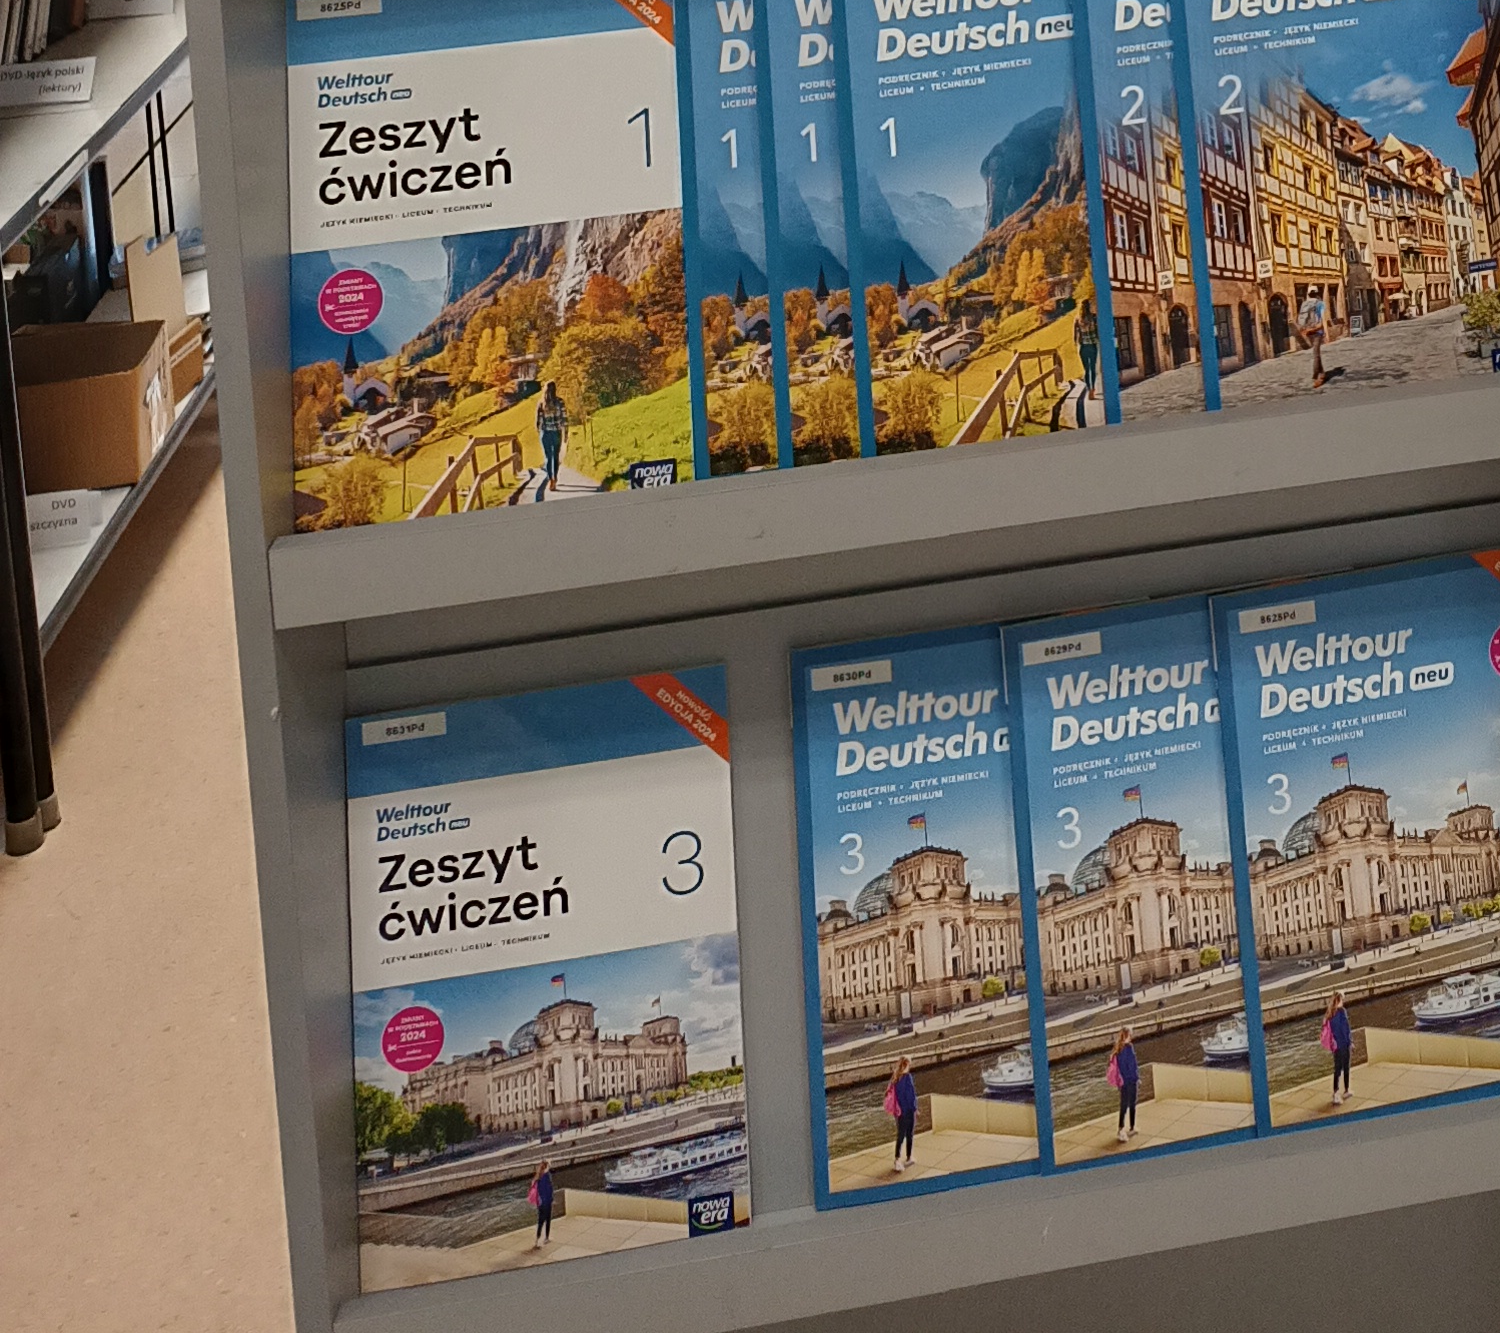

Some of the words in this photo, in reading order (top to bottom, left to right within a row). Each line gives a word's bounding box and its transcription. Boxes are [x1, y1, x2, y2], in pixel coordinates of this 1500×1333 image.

[1214, 43, 1248, 57] LICEUM
[1264, 35, 1316, 51] TECHNIKUM
[38, 82, 82, 96] (lektury)
[55, 66, 84, 79] polski
[878, 85, 914, 98] LICEUM
[930, 76, 986, 92] TECHNIKUM
[1121, 85, 1147, 127] 2
[1218, 74, 1245, 116] 2
[318, 107, 481, 158] Zeszyt
[627, 107, 652, 168] 1
[720, 128, 738, 169] 1
[800, 122, 818, 163] 1
[880, 117, 898, 158] 1
[319, 148, 513, 205] ćwiczeń
[634, 463, 675, 479] nowa
[30, 516, 78, 532] szczyzna
[51, 498, 76, 511] DVD
[1254, 627, 1413, 678] Welttour
[1045, 658, 1209, 710] Welttour
[1259, 661, 1403, 720] Deutsch
[1414, 667, 1449, 683] neu
[833, 688, 998, 735] Welttour
[1050, 695, 1199, 752] Deutsch
[836, 722, 986, 776] Deutsch
[1263, 742, 1297, 754] LICEUM
[1311, 729, 1364, 747] TECHNIKUM
[1053, 774, 1088, 788] LICEUM
[1103, 761, 1157, 780] TECHNIKUM
[1266, 773, 1292, 815] 3
[837, 800, 872, 813] LICEUM
[888, 789, 943, 805] TECHNIKUM
[1055, 806, 1082, 850] 3
[378, 836, 538, 894] Zeszyt
[661, 830, 705, 896] 3
[839, 833, 864, 876] 3
[378, 876, 569, 942] ćwiczeń
[692, 1198, 730, 1214] nowa
[700, 1207, 729, 1224] era
